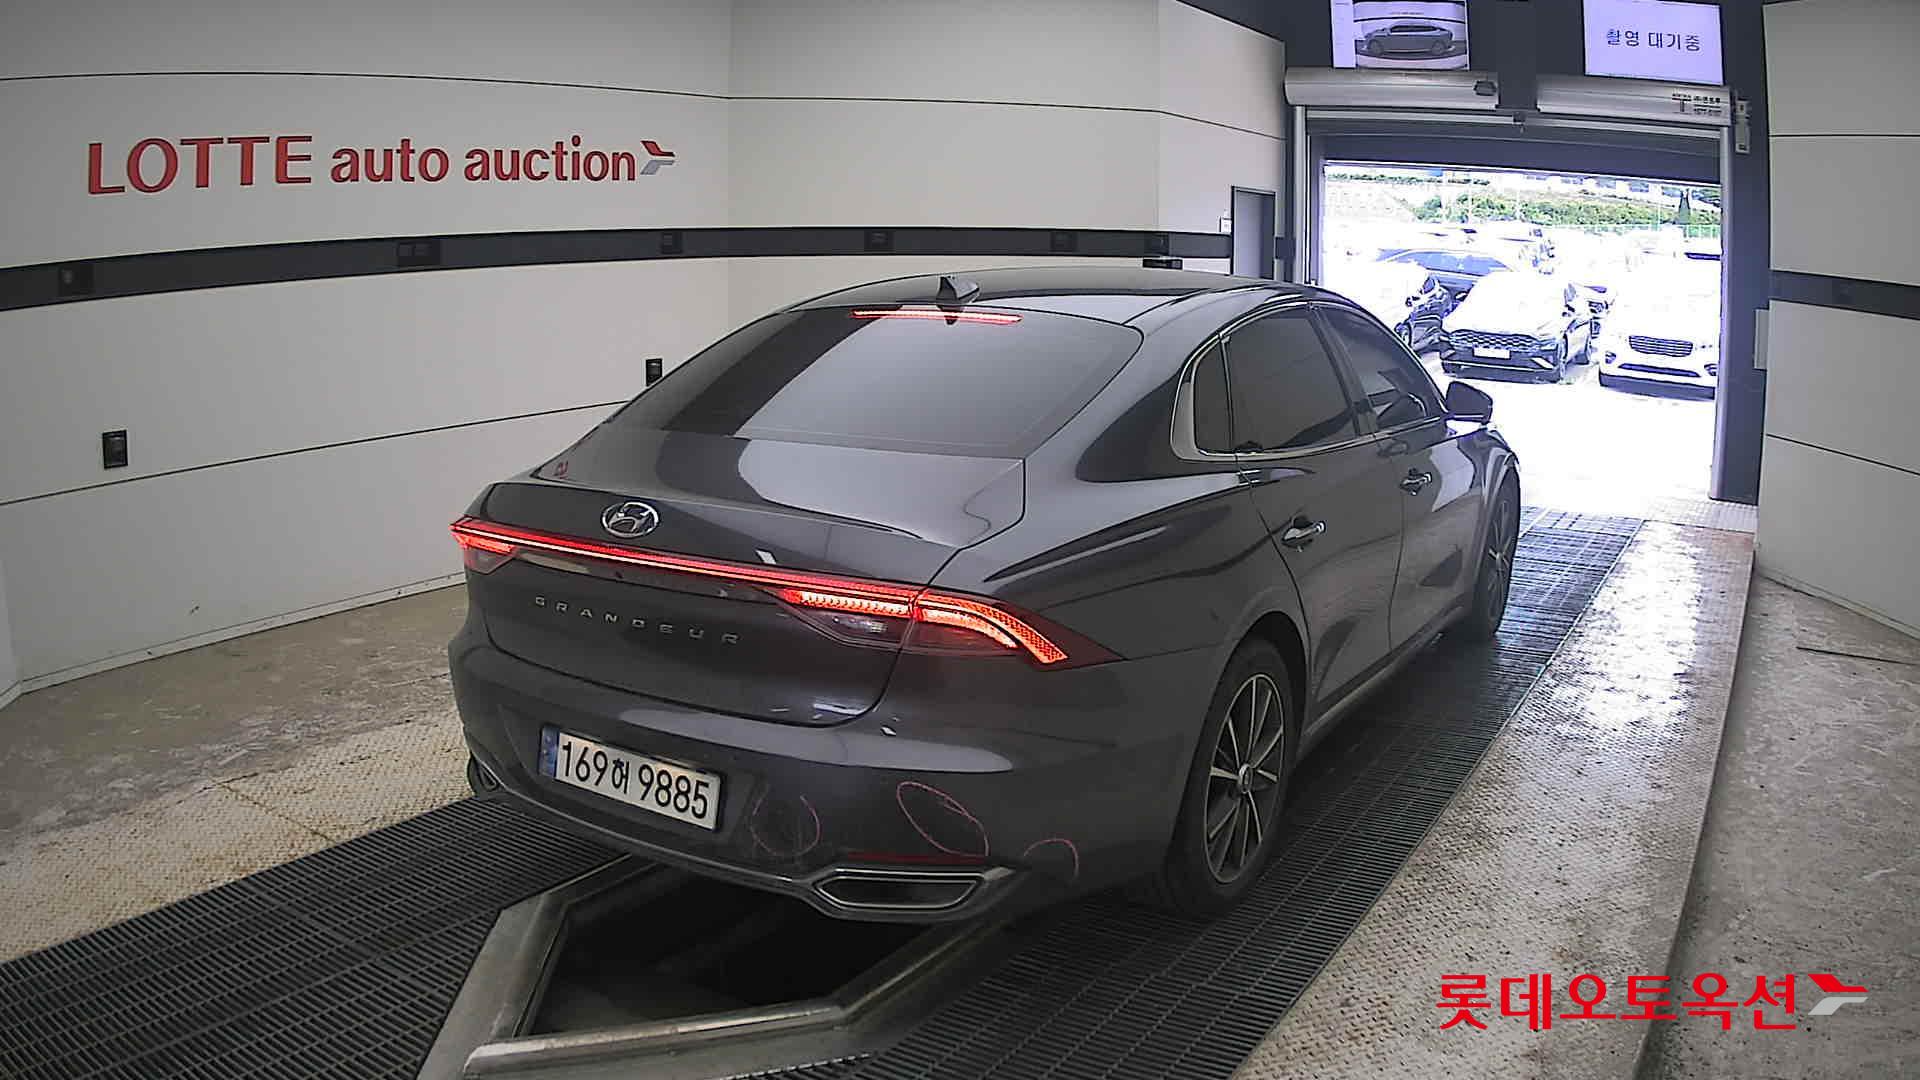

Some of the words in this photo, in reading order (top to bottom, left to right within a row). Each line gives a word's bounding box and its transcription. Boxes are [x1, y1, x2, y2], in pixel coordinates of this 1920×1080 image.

[1648, 31, 1700, 52] 대기중
[88, 135, 312, 194] LOTTE
[331, 138, 450, 183] auto
[464, 135, 637, 182] auction
[534, 596, 740, 645] GRANDEUR
[561, 741, 630, 794] 169허
[638, 763, 710, 819] 9885
